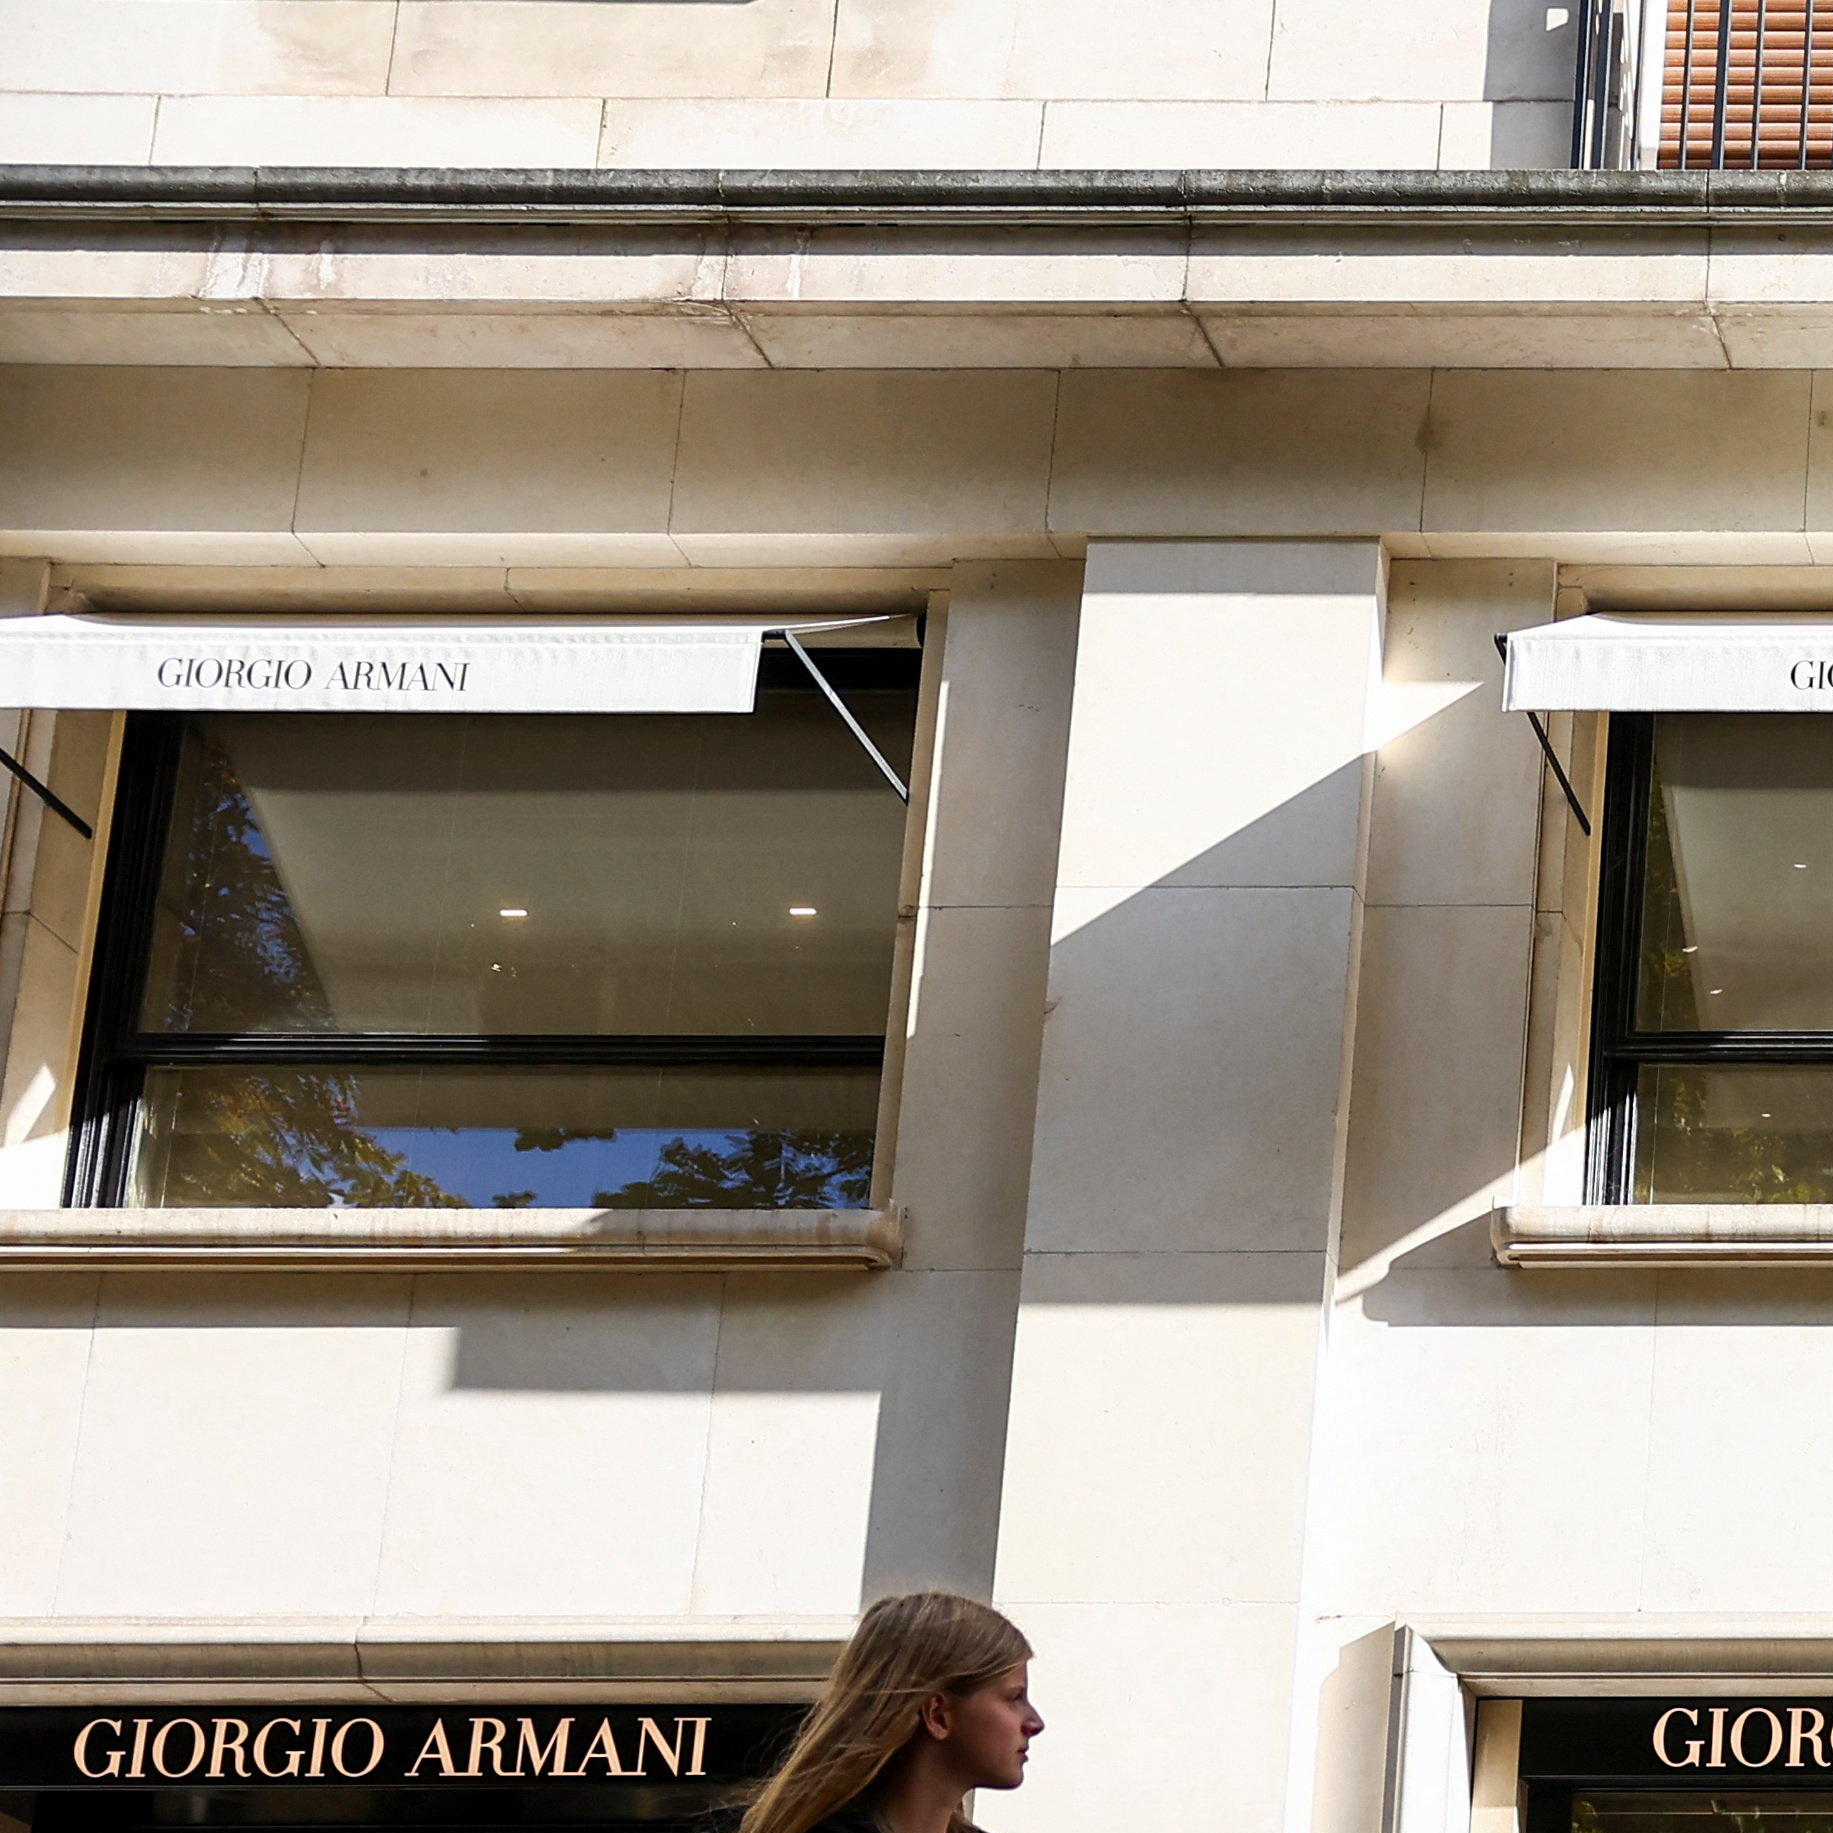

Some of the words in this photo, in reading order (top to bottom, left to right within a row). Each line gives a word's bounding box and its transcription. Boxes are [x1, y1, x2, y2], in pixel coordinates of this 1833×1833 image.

[157, 657, 313, 690] GIORGIO
[323, 660, 471, 692] ARMANI
[73, 1717, 385, 1779] GIORGIO
[403, 1716, 713, 1777] ARMANI
